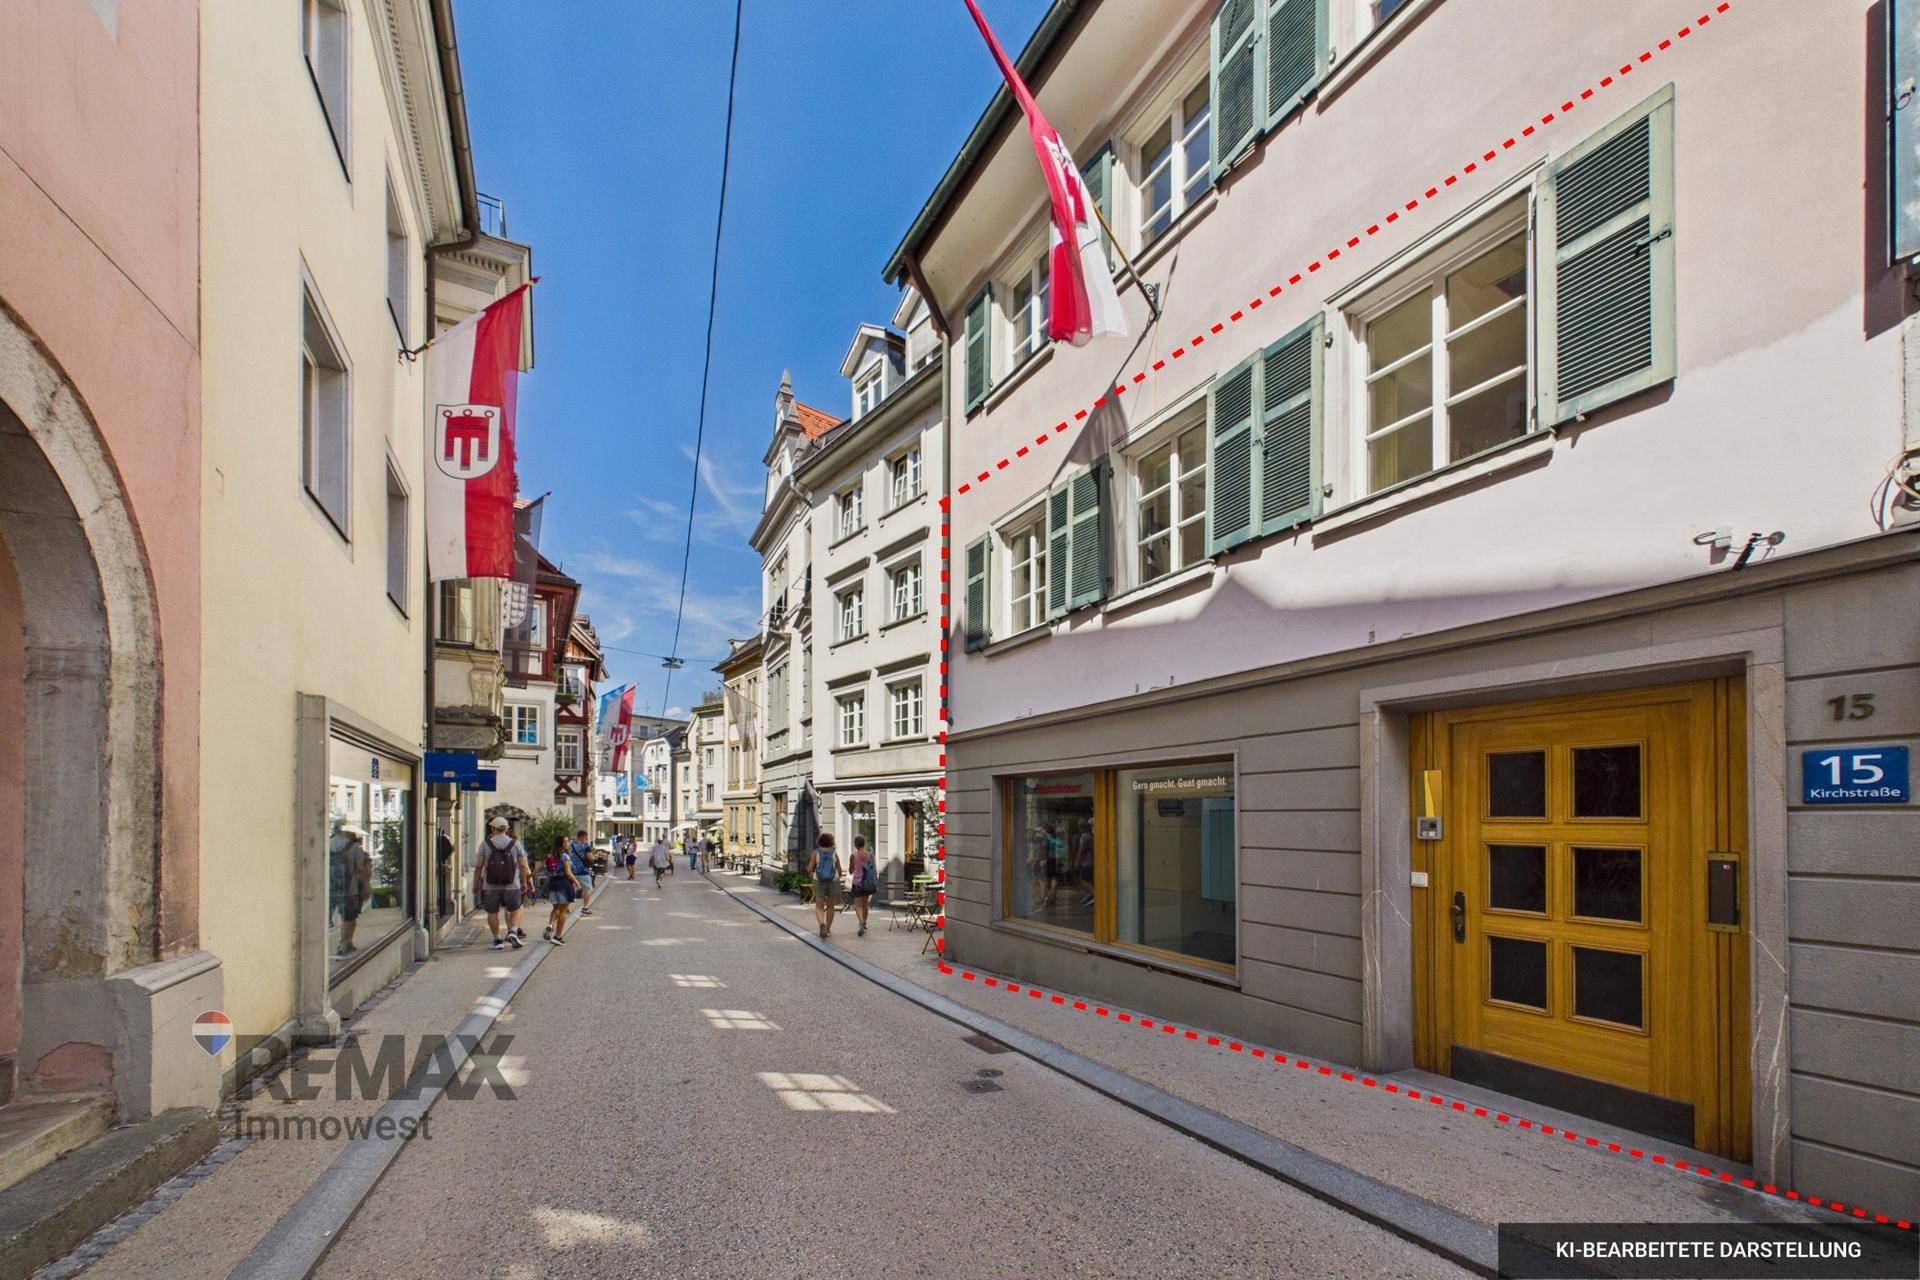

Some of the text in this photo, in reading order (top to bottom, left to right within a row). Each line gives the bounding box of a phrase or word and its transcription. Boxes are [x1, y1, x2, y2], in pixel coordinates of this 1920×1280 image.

[1827, 692, 1874, 721] 15
[1820, 754, 1884, 785] 15
[1177, 777, 1195, 788] Guat
[1196, 775, 1228, 789] gmacht.
[1810, 786, 1901, 798] Kirchstraße
